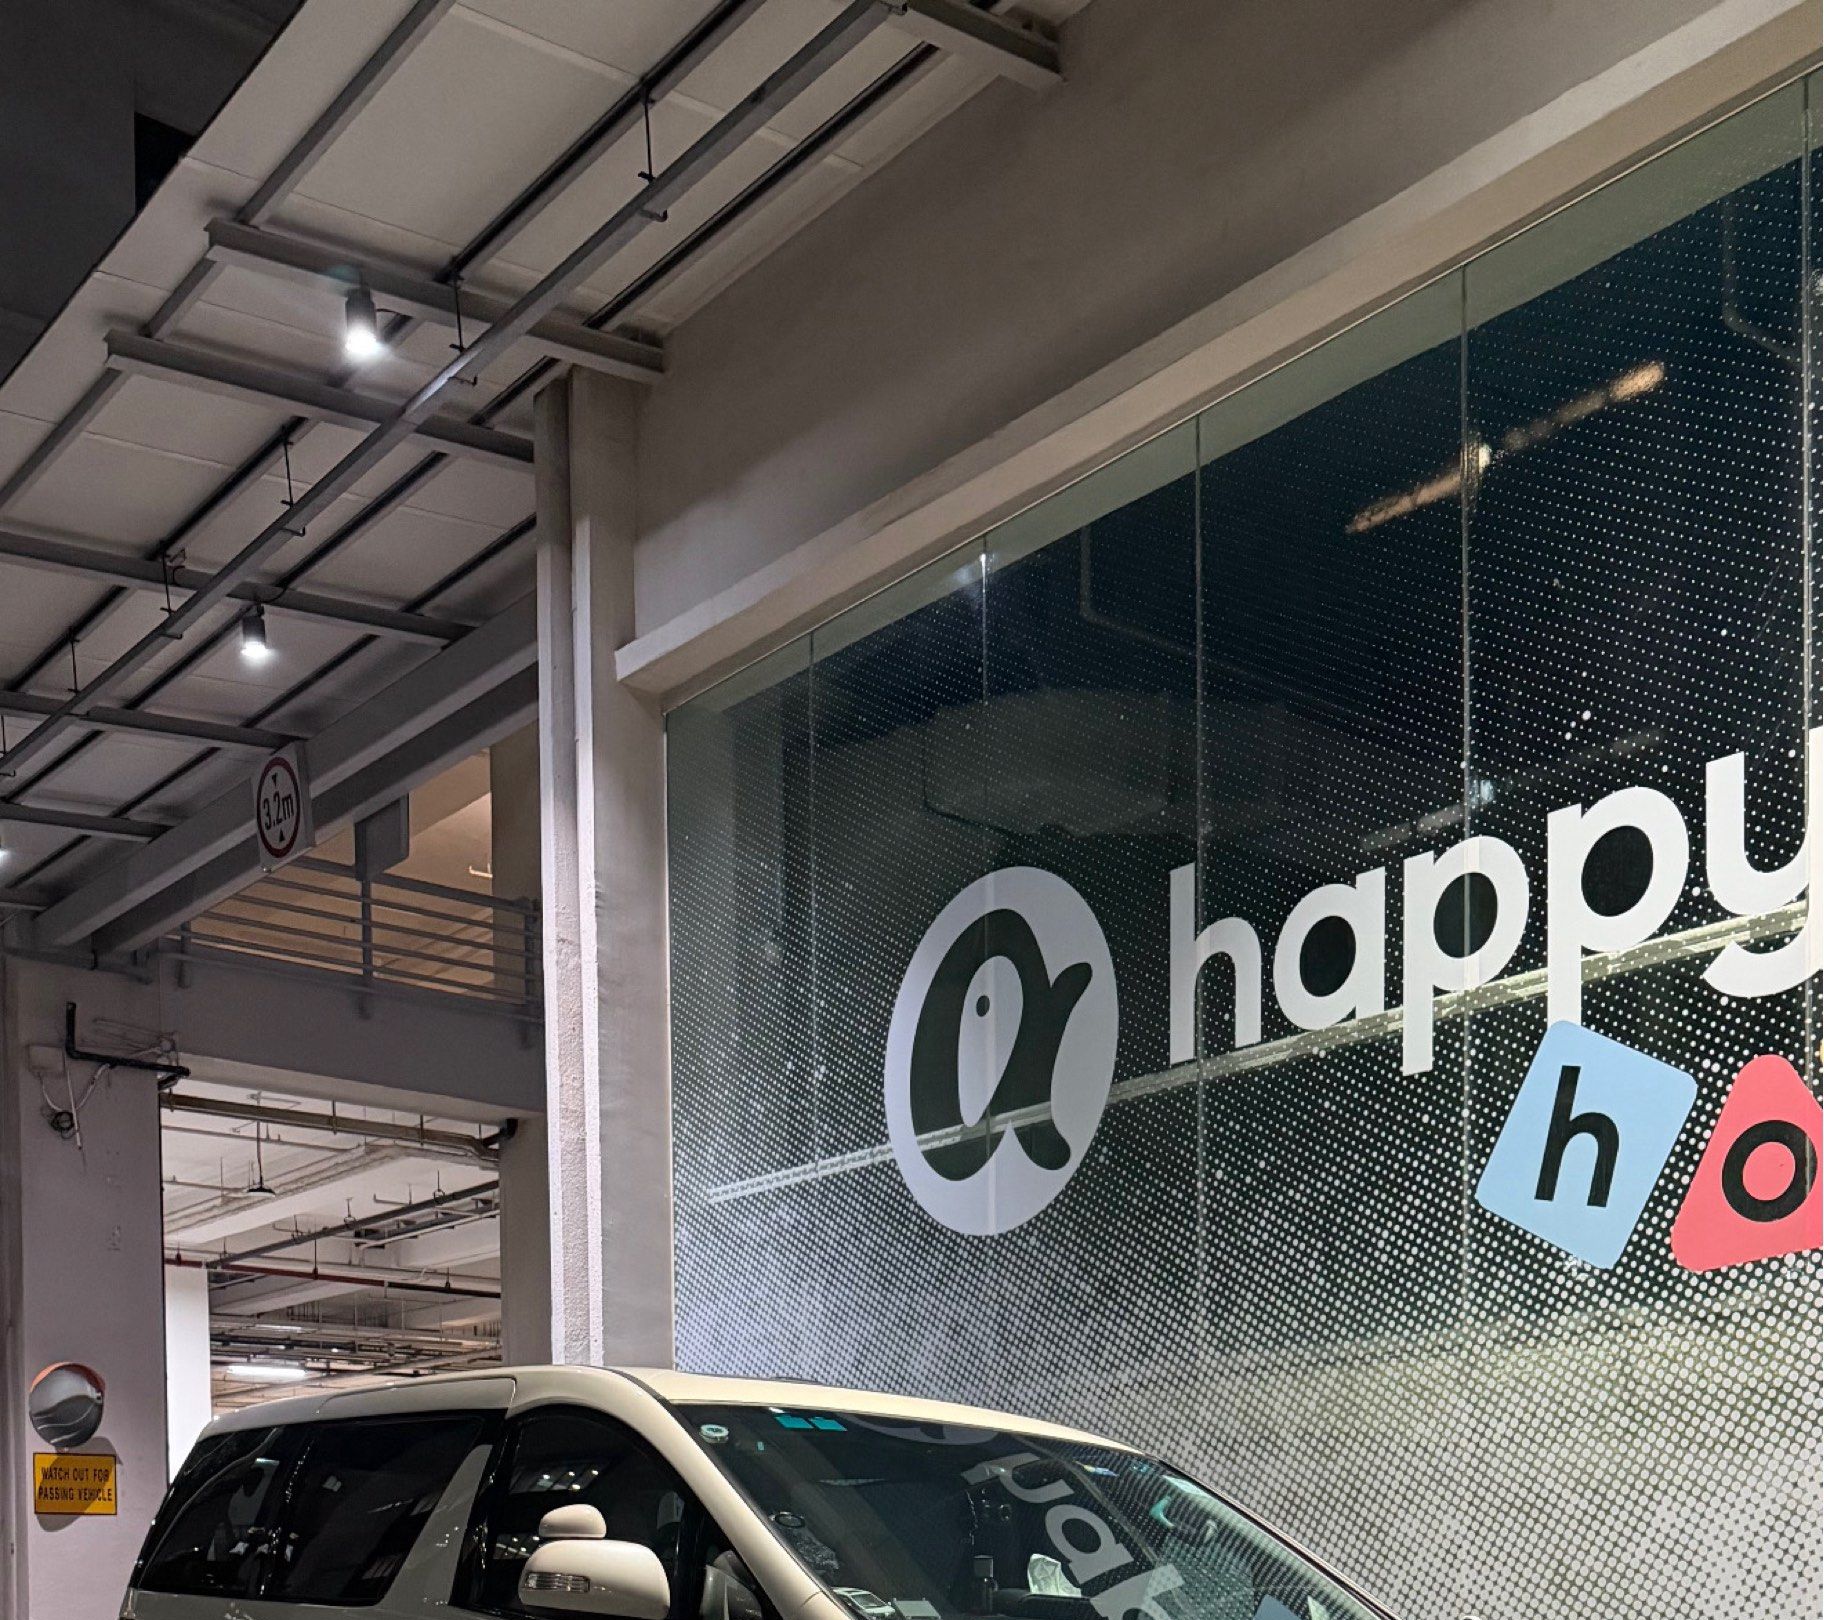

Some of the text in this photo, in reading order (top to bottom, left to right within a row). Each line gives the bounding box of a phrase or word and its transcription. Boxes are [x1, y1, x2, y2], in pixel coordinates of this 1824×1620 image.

[263, 791, 294, 830] 3.2m
[1169, 726, 1823, 1076] happy
[41, 1466, 110, 1482] WATCH OUT FOR
[38, 1485, 113, 1502] PASSING VEHICLE
